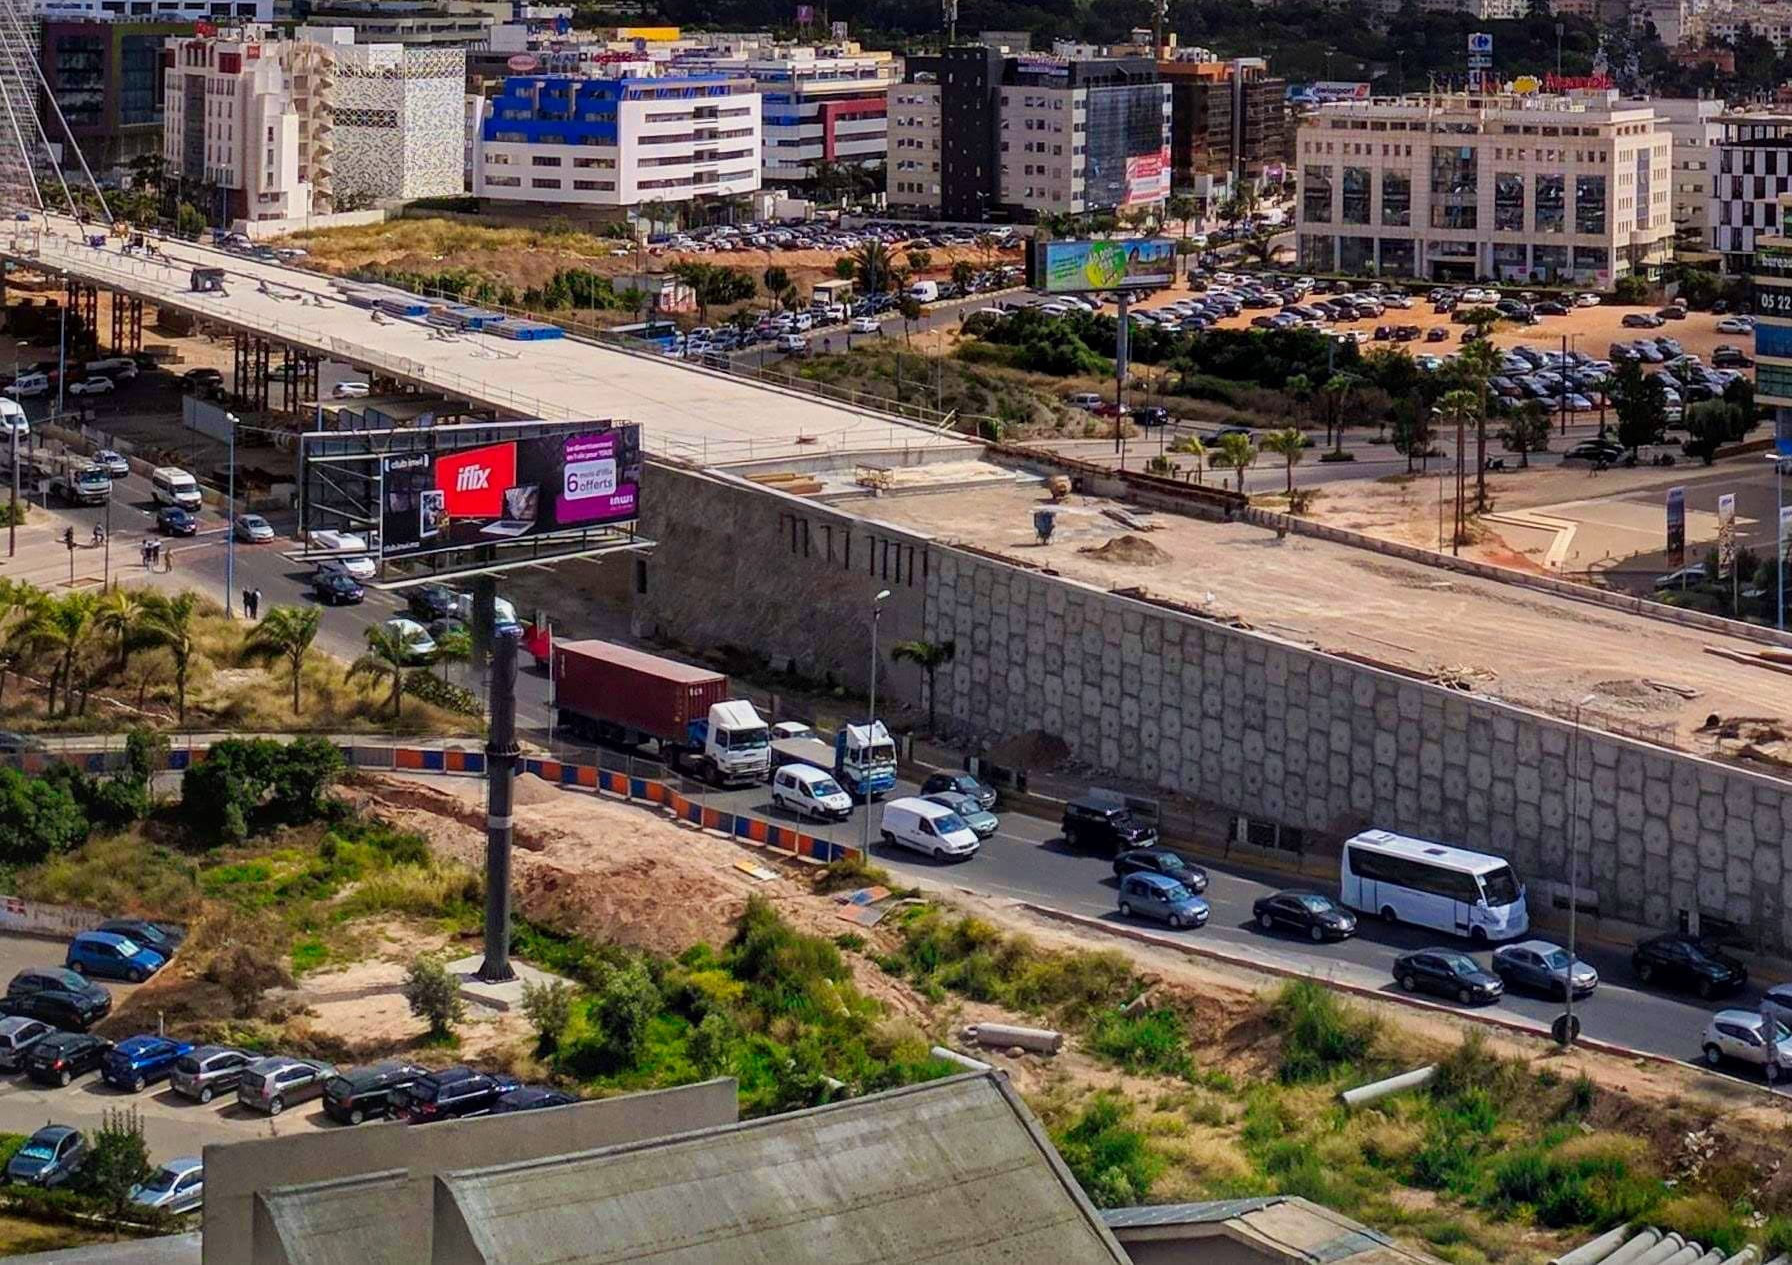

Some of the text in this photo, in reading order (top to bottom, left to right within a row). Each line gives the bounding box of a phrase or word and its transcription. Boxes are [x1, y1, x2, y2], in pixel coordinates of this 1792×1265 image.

[1761, 294, 1775, 309] 05
[1777, 295, 1791, 310] 22
[455, 464, 492, 492] iflix
[567, 472, 579, 493] 6
[579, 478, 614, 492] offerts
